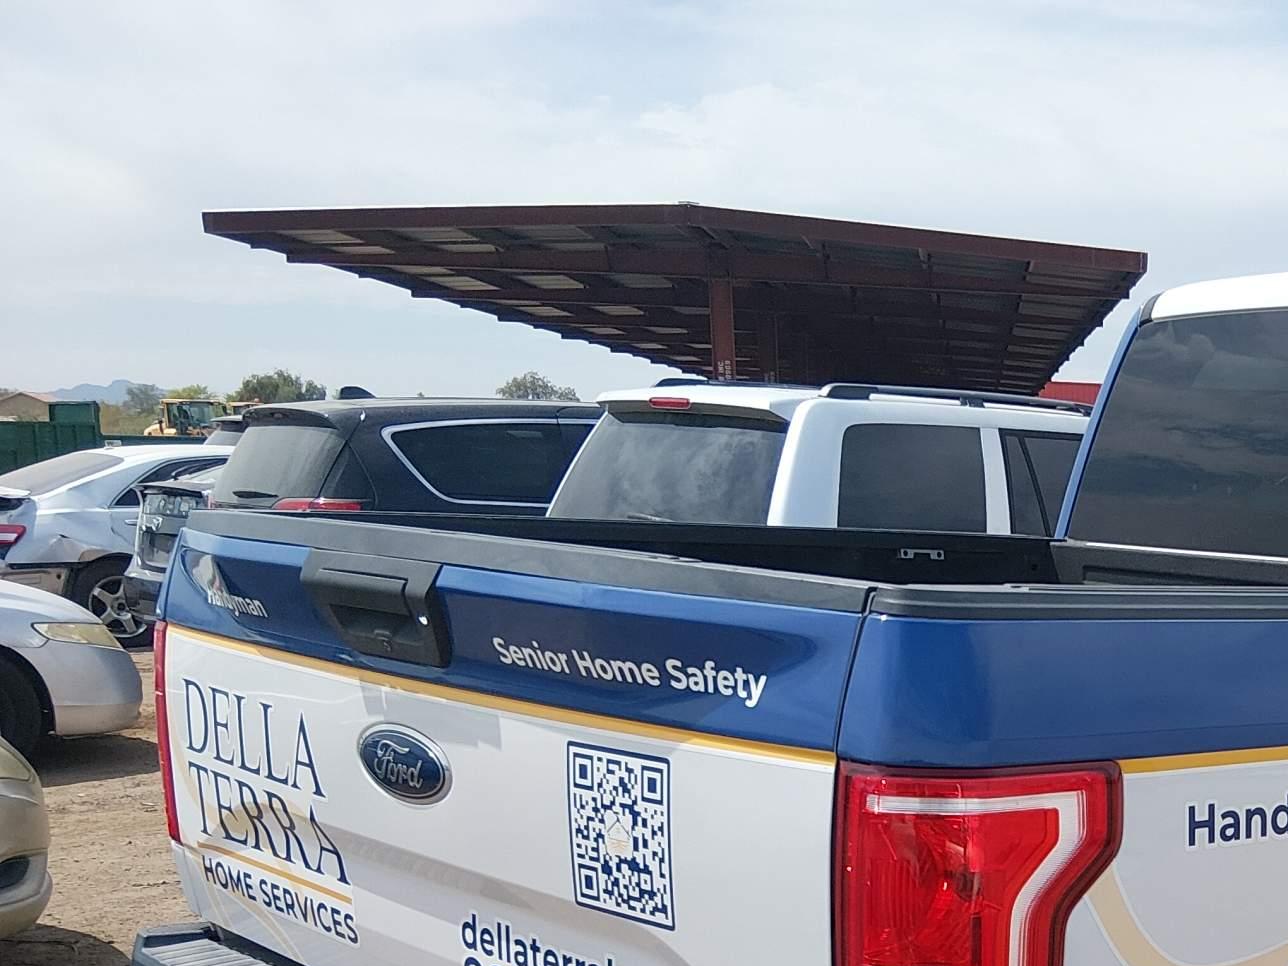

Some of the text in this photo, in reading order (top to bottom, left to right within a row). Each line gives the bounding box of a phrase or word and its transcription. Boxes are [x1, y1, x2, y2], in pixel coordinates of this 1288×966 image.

[207, 586, 268, 617] Handyman
[492, 637, 767, 708] Senior Home Safety
[183, 678, 326, 798] DELLA
[374, 740, 423, 788] Ford
[188, 760, 351, 886] TERRA
[202, 854, 359, 944] HOME SERVICES
